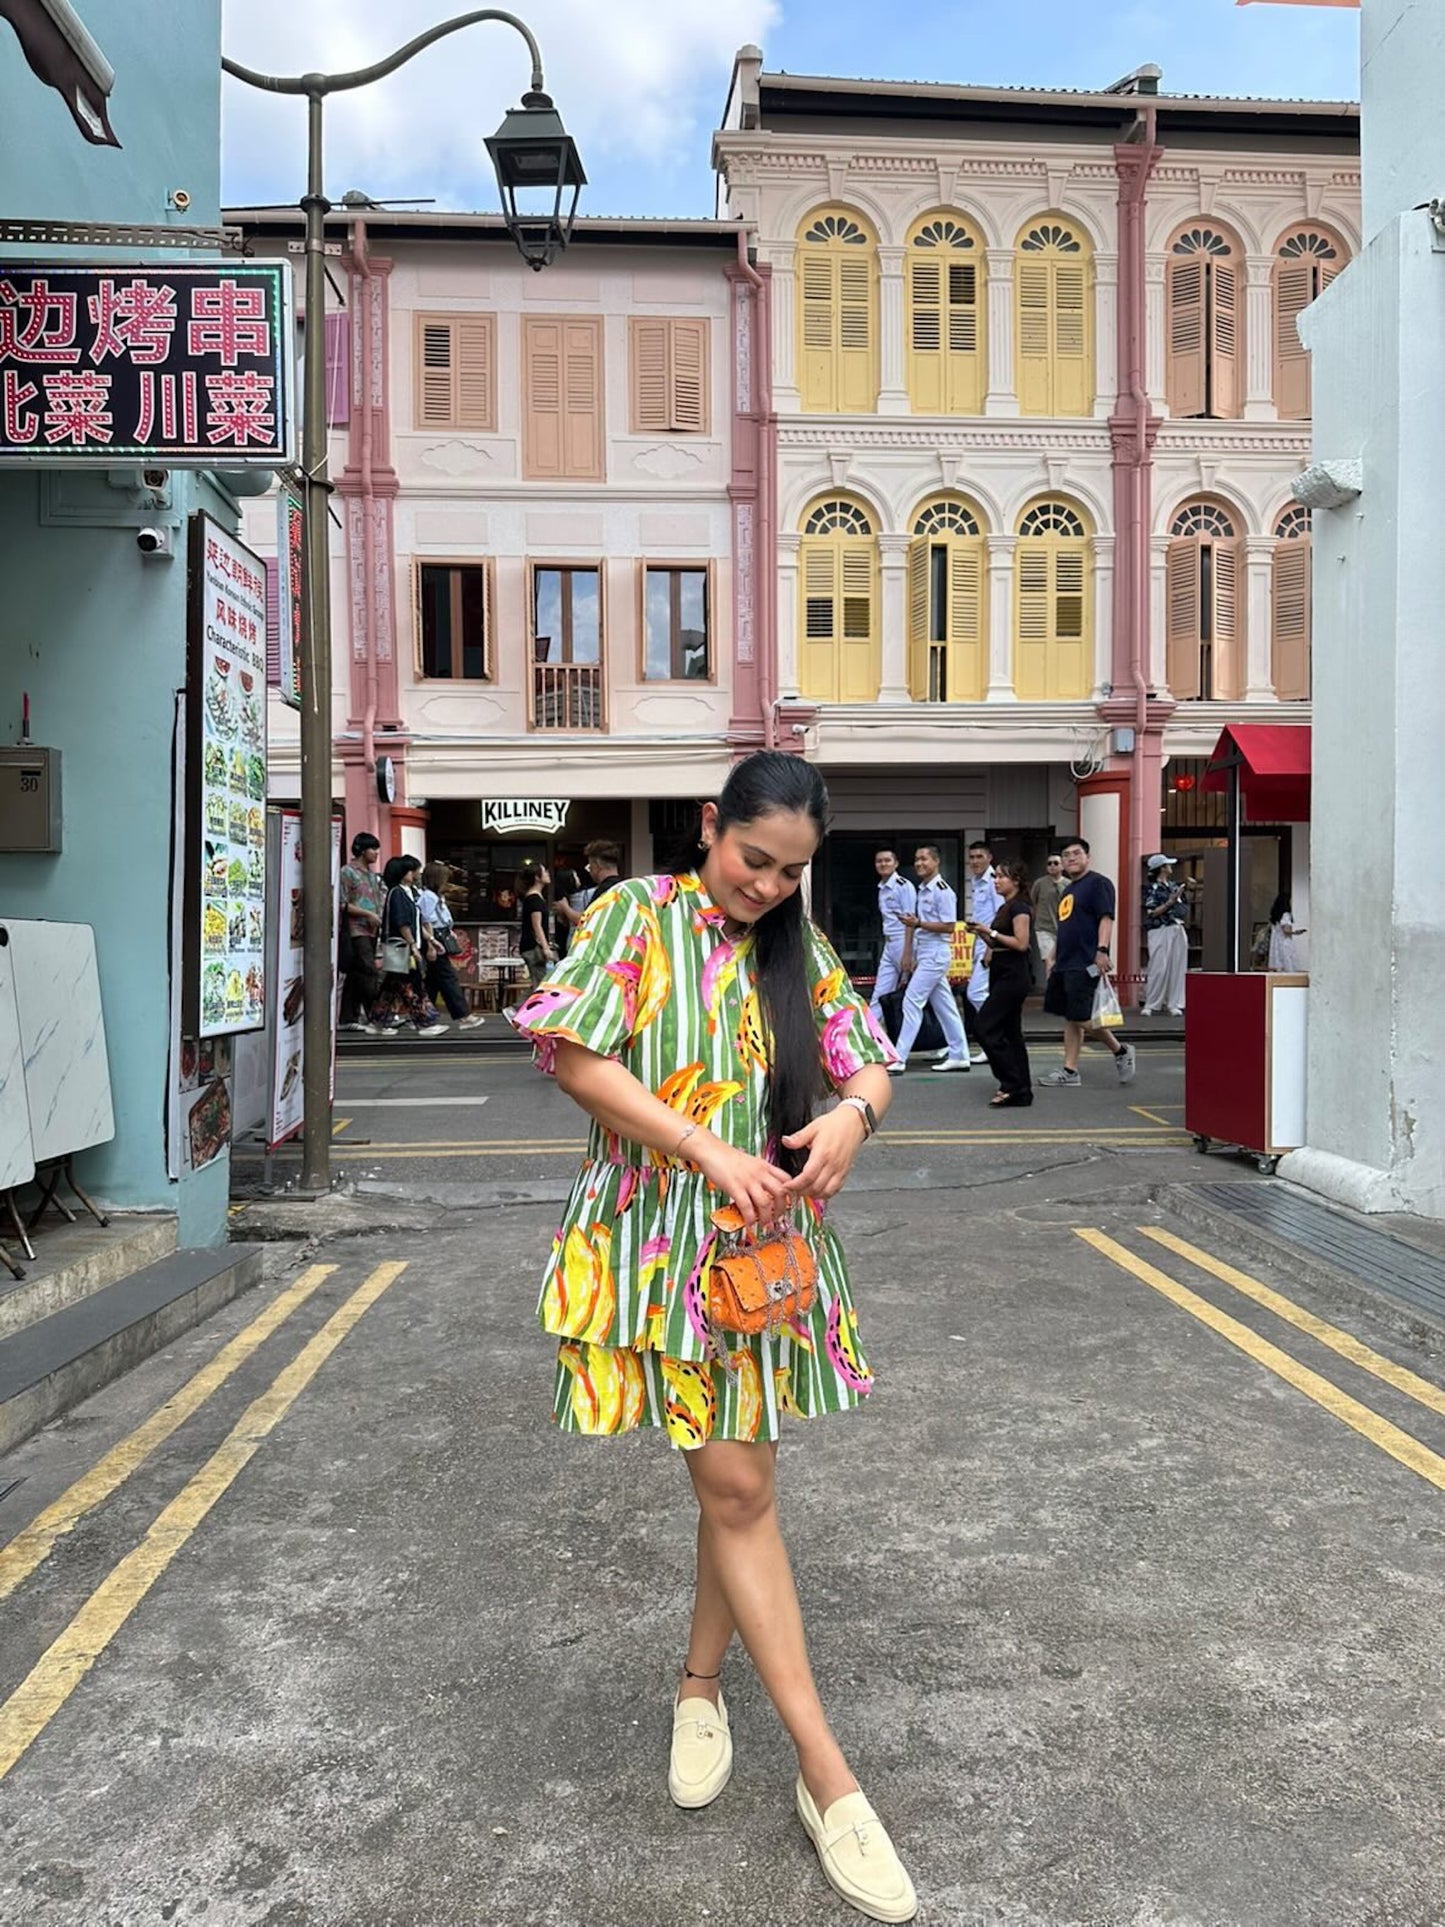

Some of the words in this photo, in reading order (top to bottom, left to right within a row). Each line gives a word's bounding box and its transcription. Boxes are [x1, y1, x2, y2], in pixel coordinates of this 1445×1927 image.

[0, 279, 270, 366] 边烤串
[133, 370, 276, 445] 川菜
[207, 624, 250, 664] Characteristic
[20, 776, 39, 792] 30
[485, 801, 567, 824] KILLINEY
